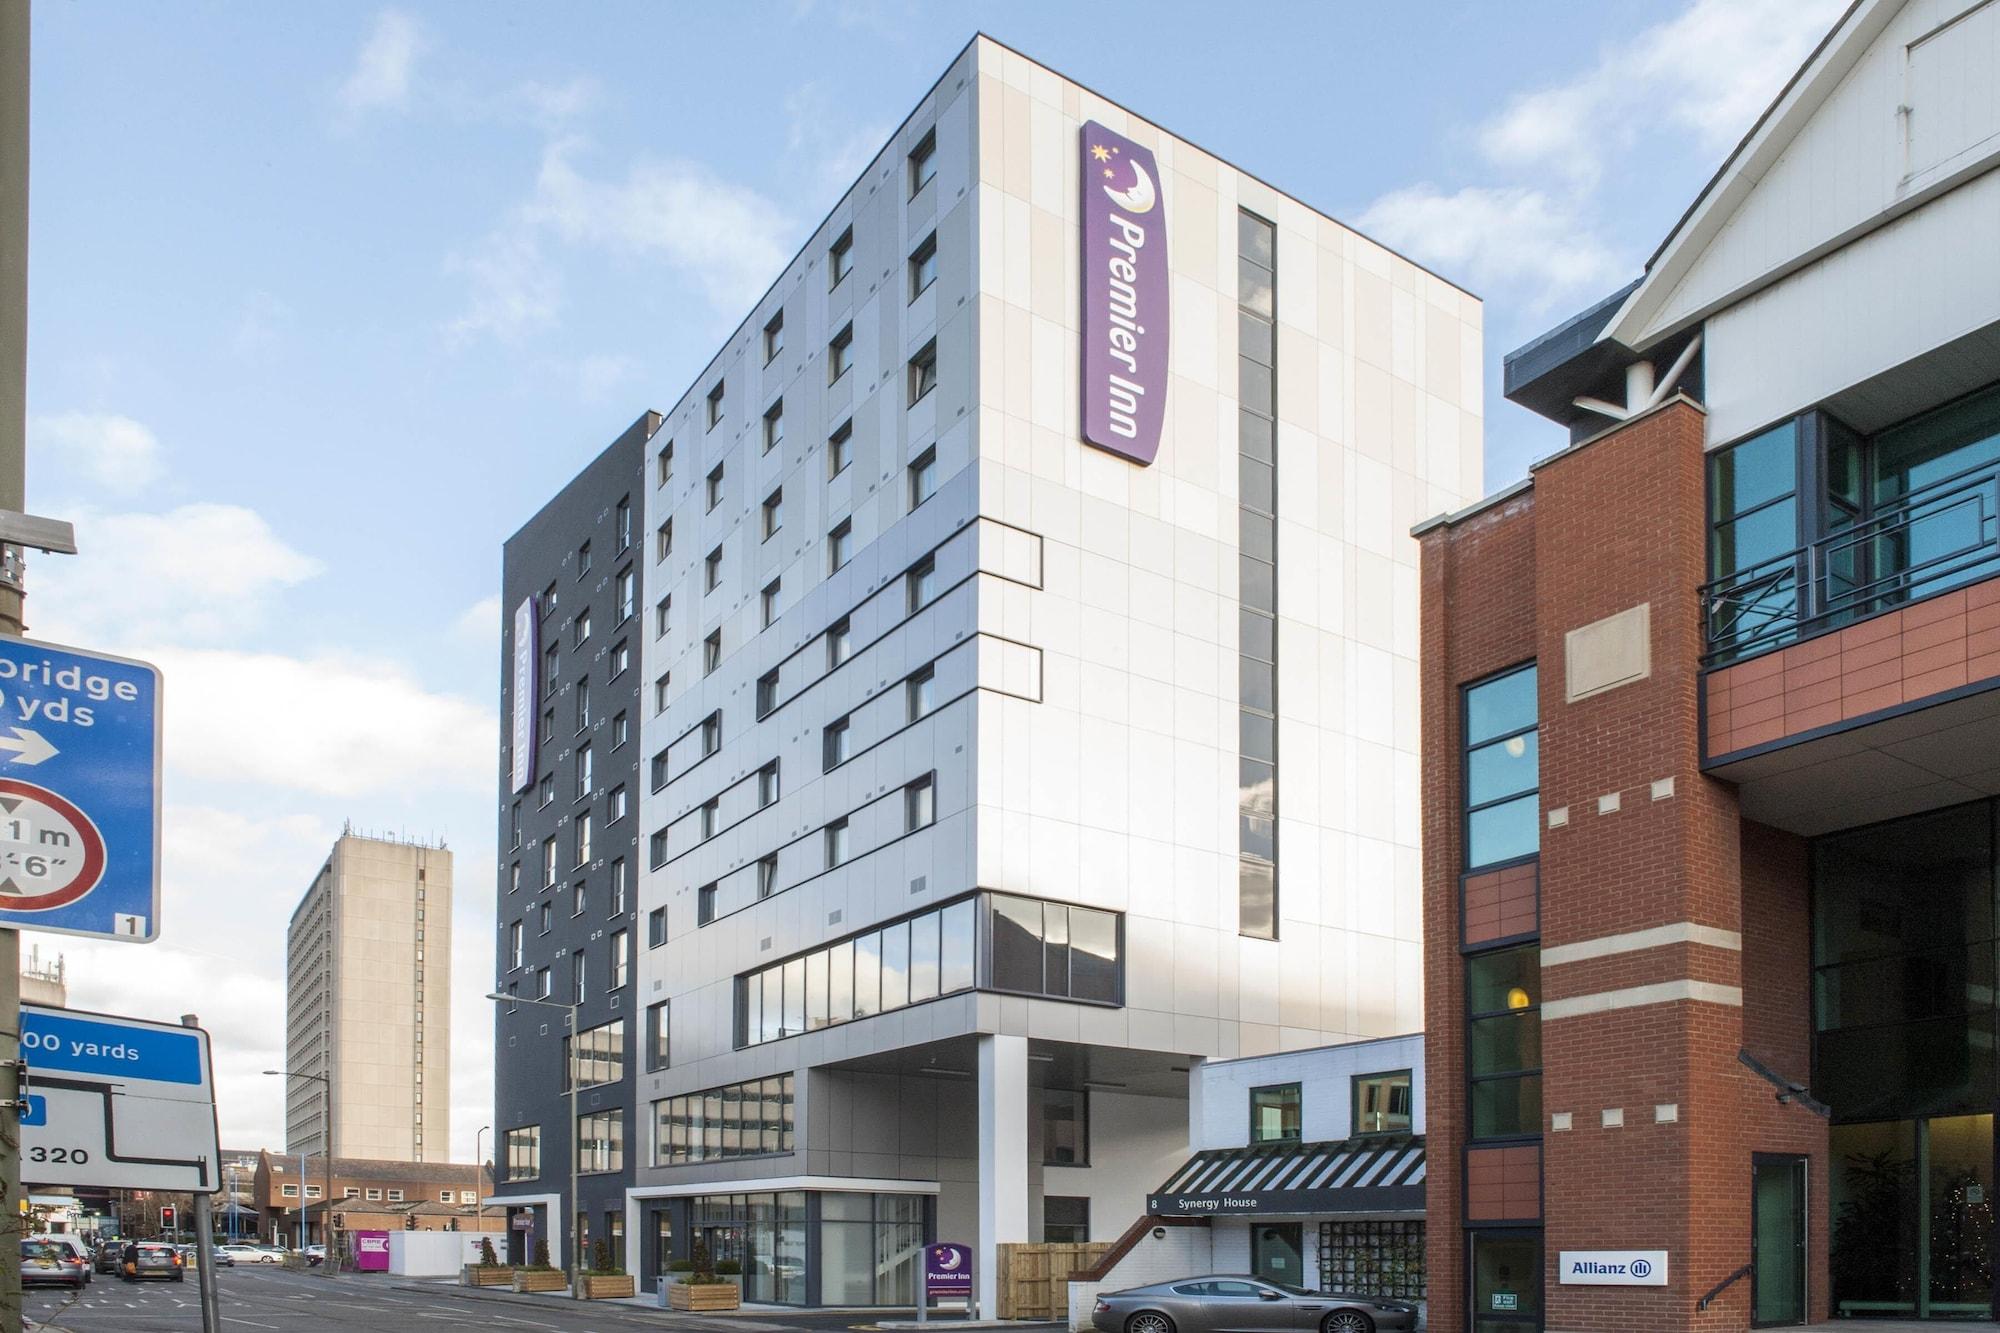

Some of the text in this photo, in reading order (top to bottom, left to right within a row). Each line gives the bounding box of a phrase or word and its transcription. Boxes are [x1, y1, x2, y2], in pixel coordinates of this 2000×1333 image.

[1109, 212, 1145, 439] Premier Inn
[17, 697, 95, 727] yds
[39, 829, 70, 847] m
[125, 917, 136, 935] 1
[71, 1041, 140, 1061] yards
[1151, 1197, 1257, 1210] 8 Synergy House
[928, 1272, 970, 1280] Premier Inn
[1572, 1261, 1626, 1274] Allianz
